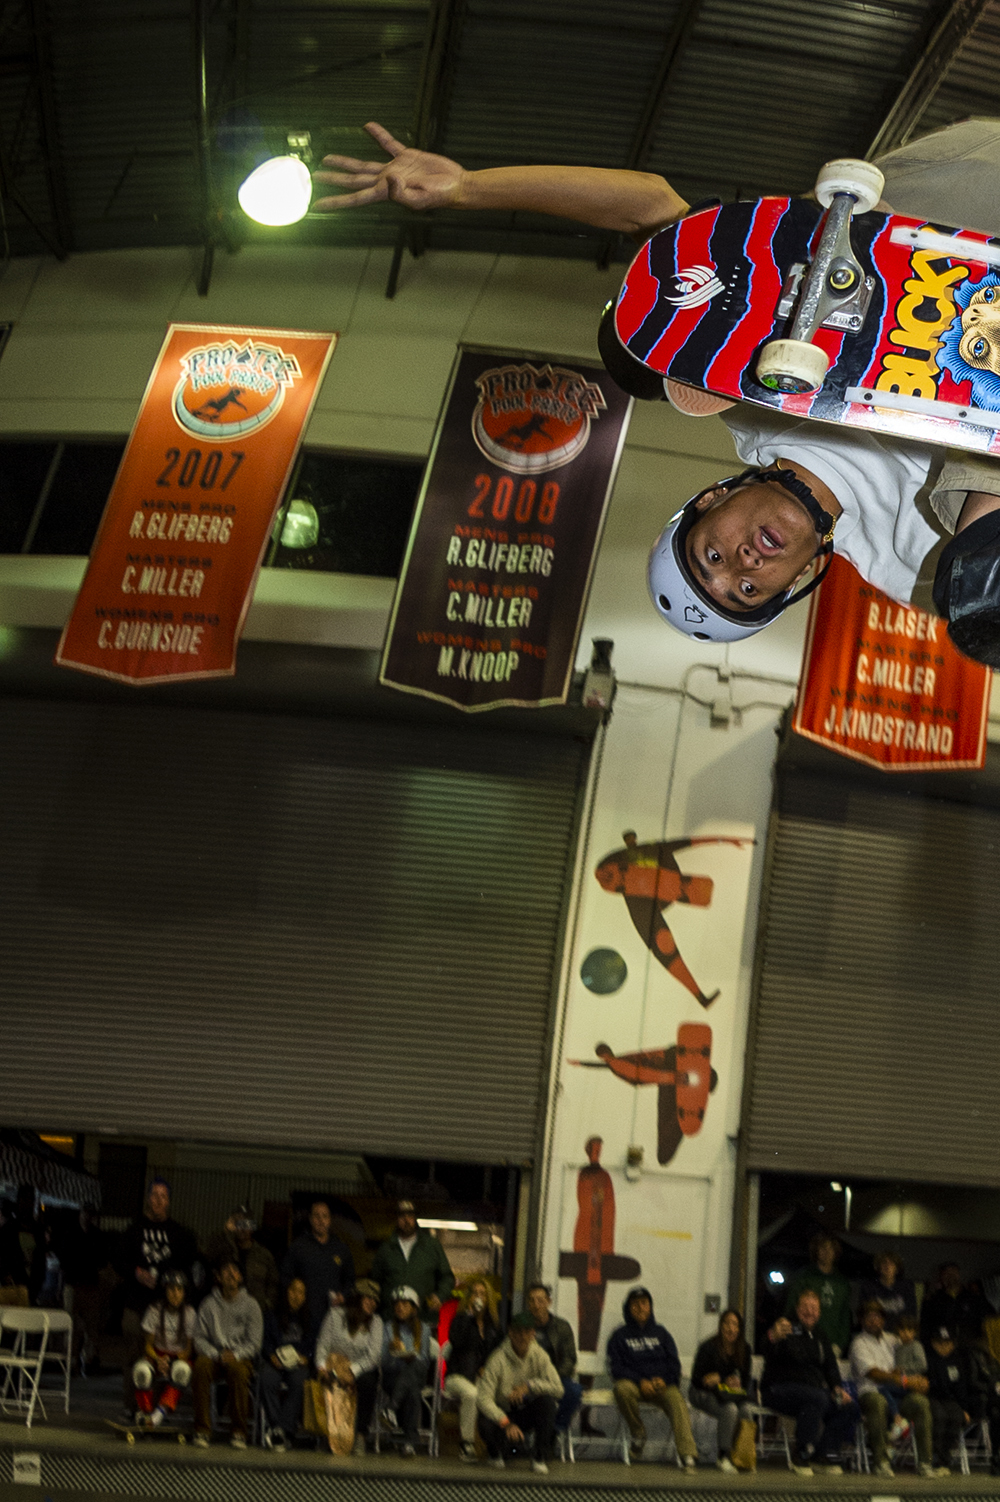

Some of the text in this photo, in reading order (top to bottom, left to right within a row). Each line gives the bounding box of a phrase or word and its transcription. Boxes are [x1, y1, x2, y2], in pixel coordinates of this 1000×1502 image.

[155, 447, 245, 491] 2007
[467, 473, 560, 525] 2008
[446, 535, 554, 577] R.GLIFBERG
[121, 565, 205, 597] C.MILLER
[446, 591, 533, 628] C.MILLER
[868, 602, 937, 642] B.LASEK
[97, 620, 204, 654] C.BURNSIDE
[437, 645, 519, 682] M.KNOOP
[857, 653, 936, 697] C.MILLER
[824, 704, 953, 755] J.KINDSTRAND
